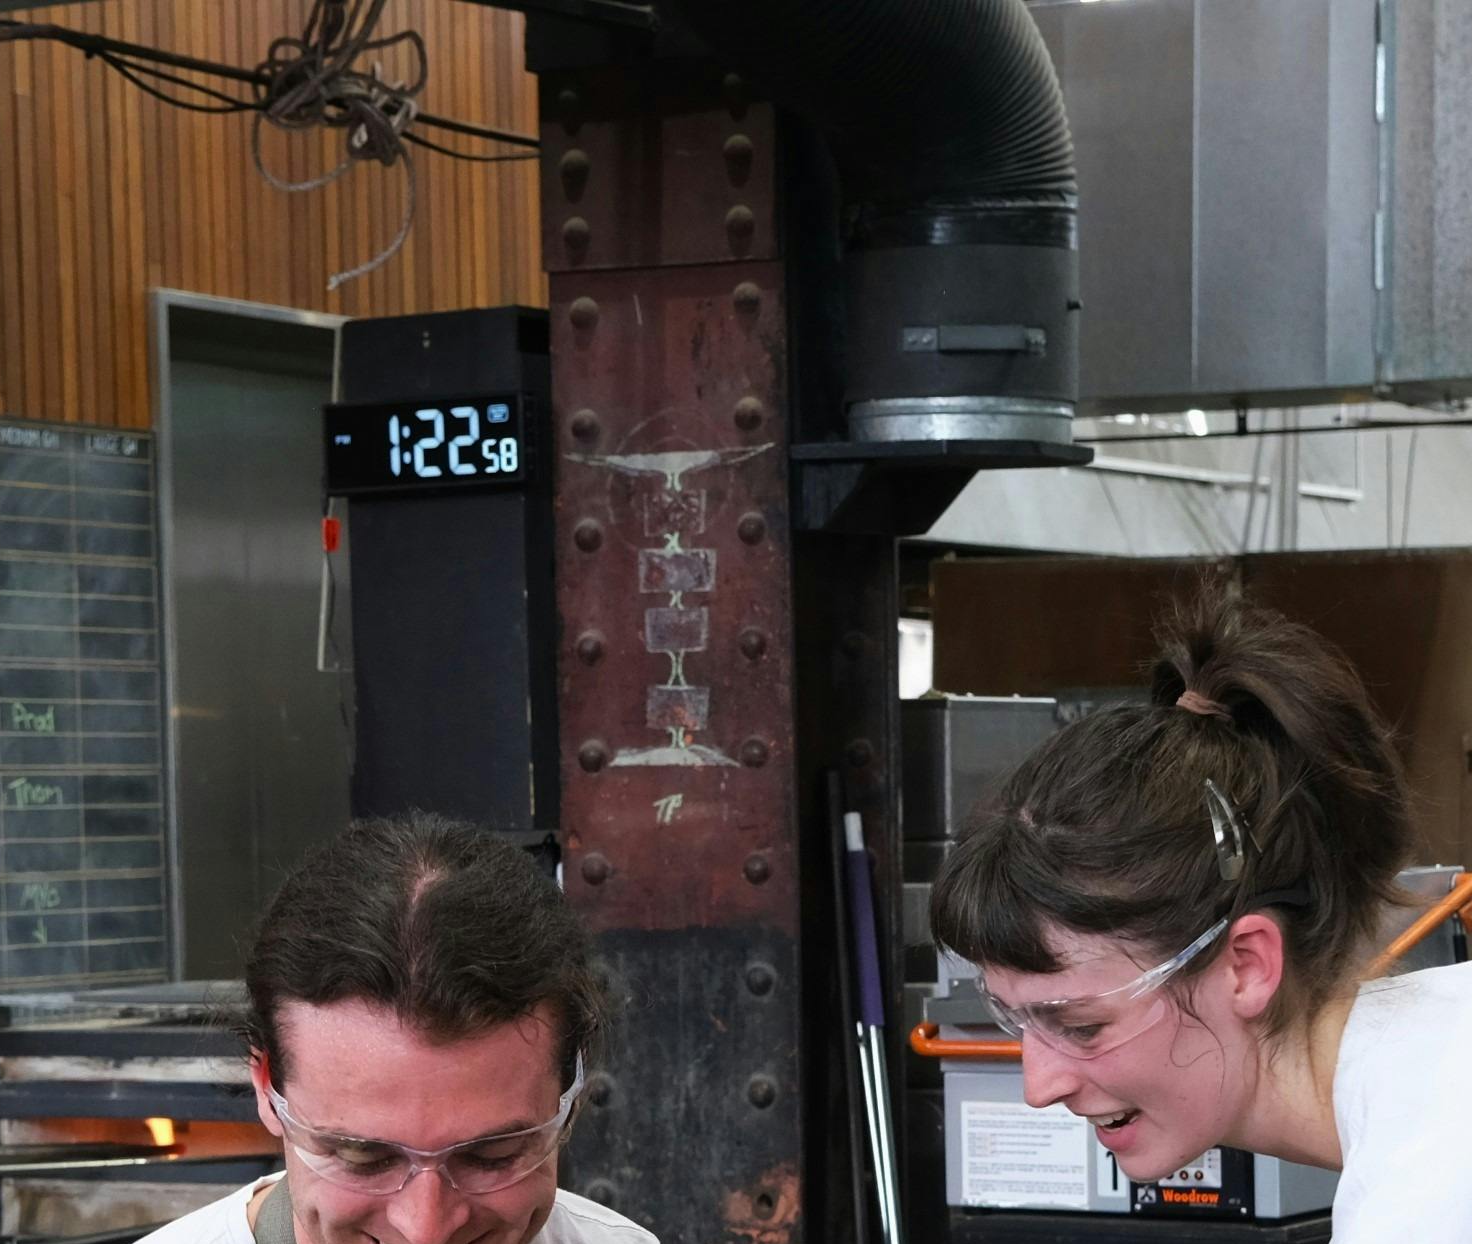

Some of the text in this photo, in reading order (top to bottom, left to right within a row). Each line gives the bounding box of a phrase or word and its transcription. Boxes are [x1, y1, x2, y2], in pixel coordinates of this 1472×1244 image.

[389, 406, 480, 478] 1:22
[481, 437, 518, 474] 58
[1162, 1187, 1220, 1204] Woodrow
